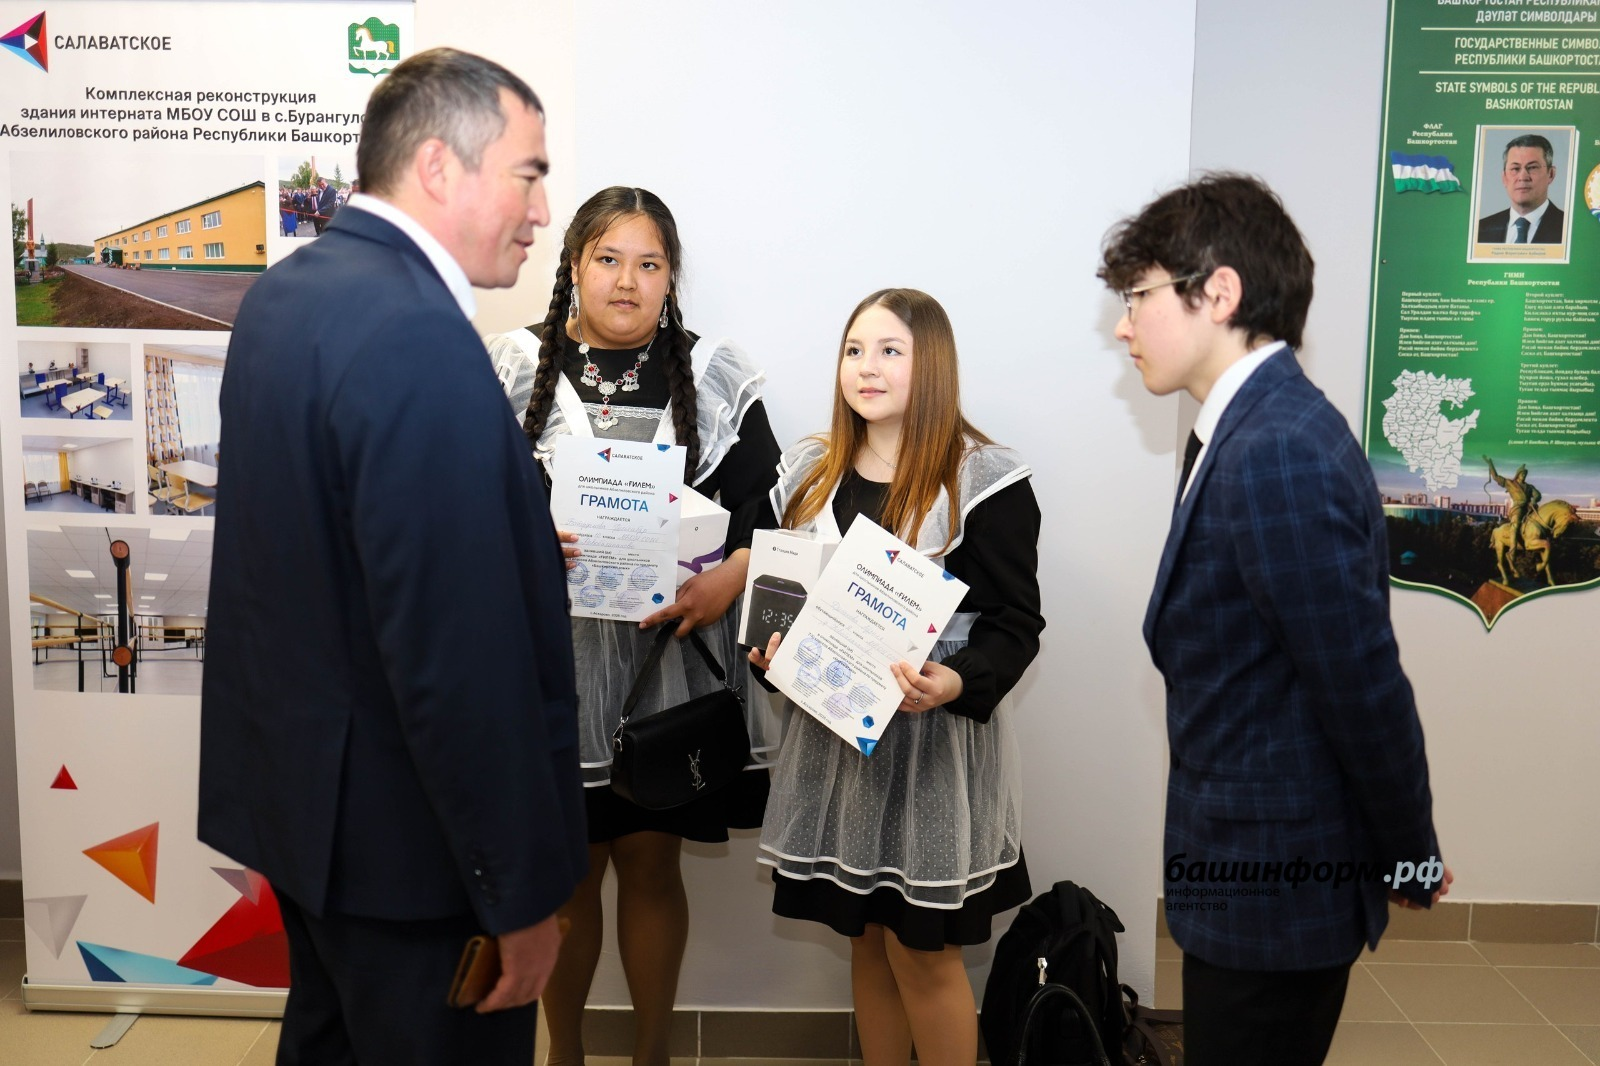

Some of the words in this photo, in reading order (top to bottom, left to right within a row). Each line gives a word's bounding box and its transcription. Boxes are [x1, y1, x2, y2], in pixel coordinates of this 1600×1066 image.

[1520, 11, 1597, 23] СИМВОЛДАРЫ
[54, 35, 171, 51] САЛАВАТСКОЕ
[1455, 37, 1559, 51] ГОСУДАРСТВЕННЫЕ
[1562, 38, 1600, 49] СИМВО
[1455, 54, 1526, 65] РЕСПУБЛИКИ
[1529, 55, 1600, 66] БАШКОРТОСТ
[86, 87, 192, 102] Комплексная
[196, 91, 316, 105] реконструкция
[1435, 82, 1466, 93] STATE
[1470, 82, 1517, 93] SYMBOLS
[1520, 82, 1534, 93] OF
[1537, 82, 1556, 93] THE
[1559, 82, 1600, 94] REPUBL
[1485, 98, 1573, 110] BASHKORTOSTAN
[21, 107, 75, 120] здания
[80, 109, 161, 122] интерната
[167, 107, 213, 121] МБОУ
[217, 108, 256, 122] СОШ
[262, 112, 270, 121] в
[274, 109, 365, 126] с.Бурангуло
[0, 123, 128, 138] Абзелиловского
[133, 126, 188, 142] района
[193, 127, 287, 144] Республики
[291, 128, 360, 145] Башкорт
[578, 475, 623, 487] ОЛИМПИАДА
[580, 493, 649, 513] ГРАМОТА
[855, 562, 895, 593] ОЛИМПИАДА
[846, 581, 909, 630] ГРАМОТА
